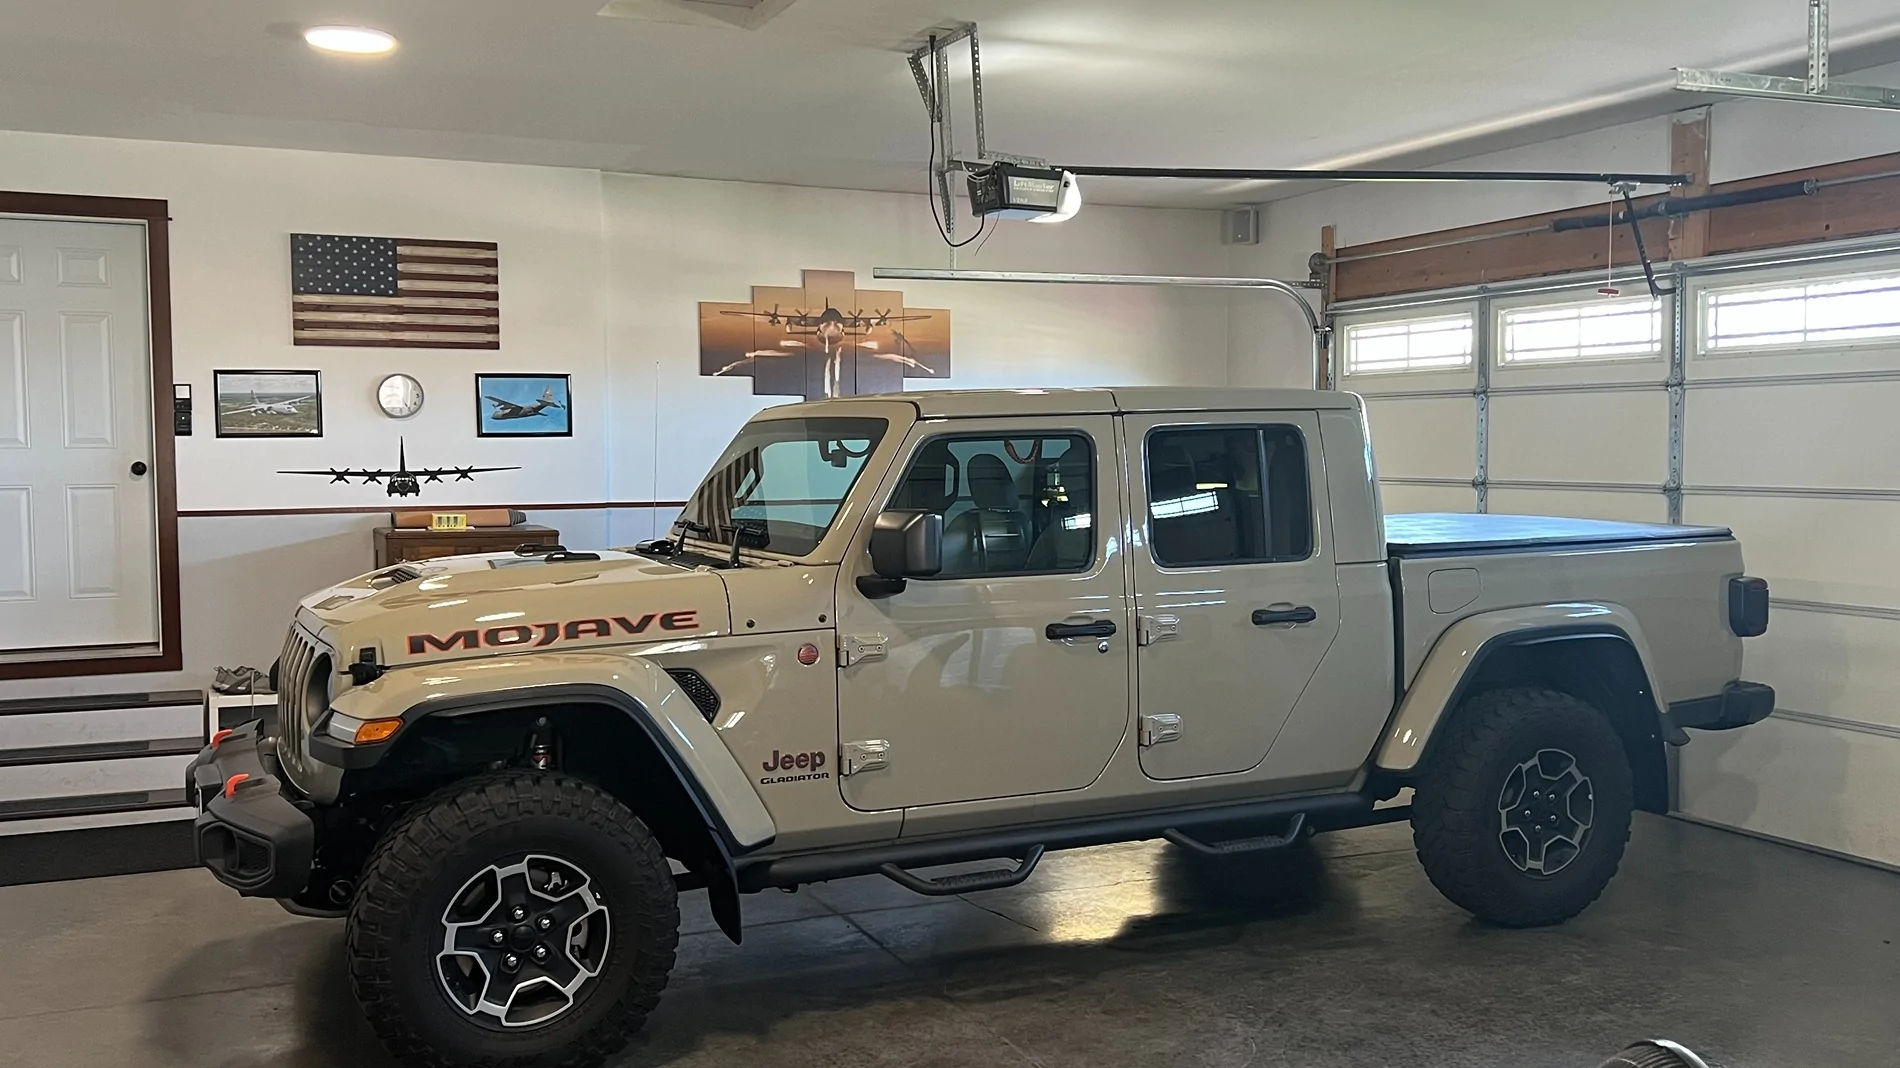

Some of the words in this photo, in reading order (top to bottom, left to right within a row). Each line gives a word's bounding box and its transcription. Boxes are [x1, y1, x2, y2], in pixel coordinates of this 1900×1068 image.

[408, 610, 700, 655] MOJAVE
[762, 749, 826, 772] Jeep
[760, 772, 830, 785] GLADIATOR
